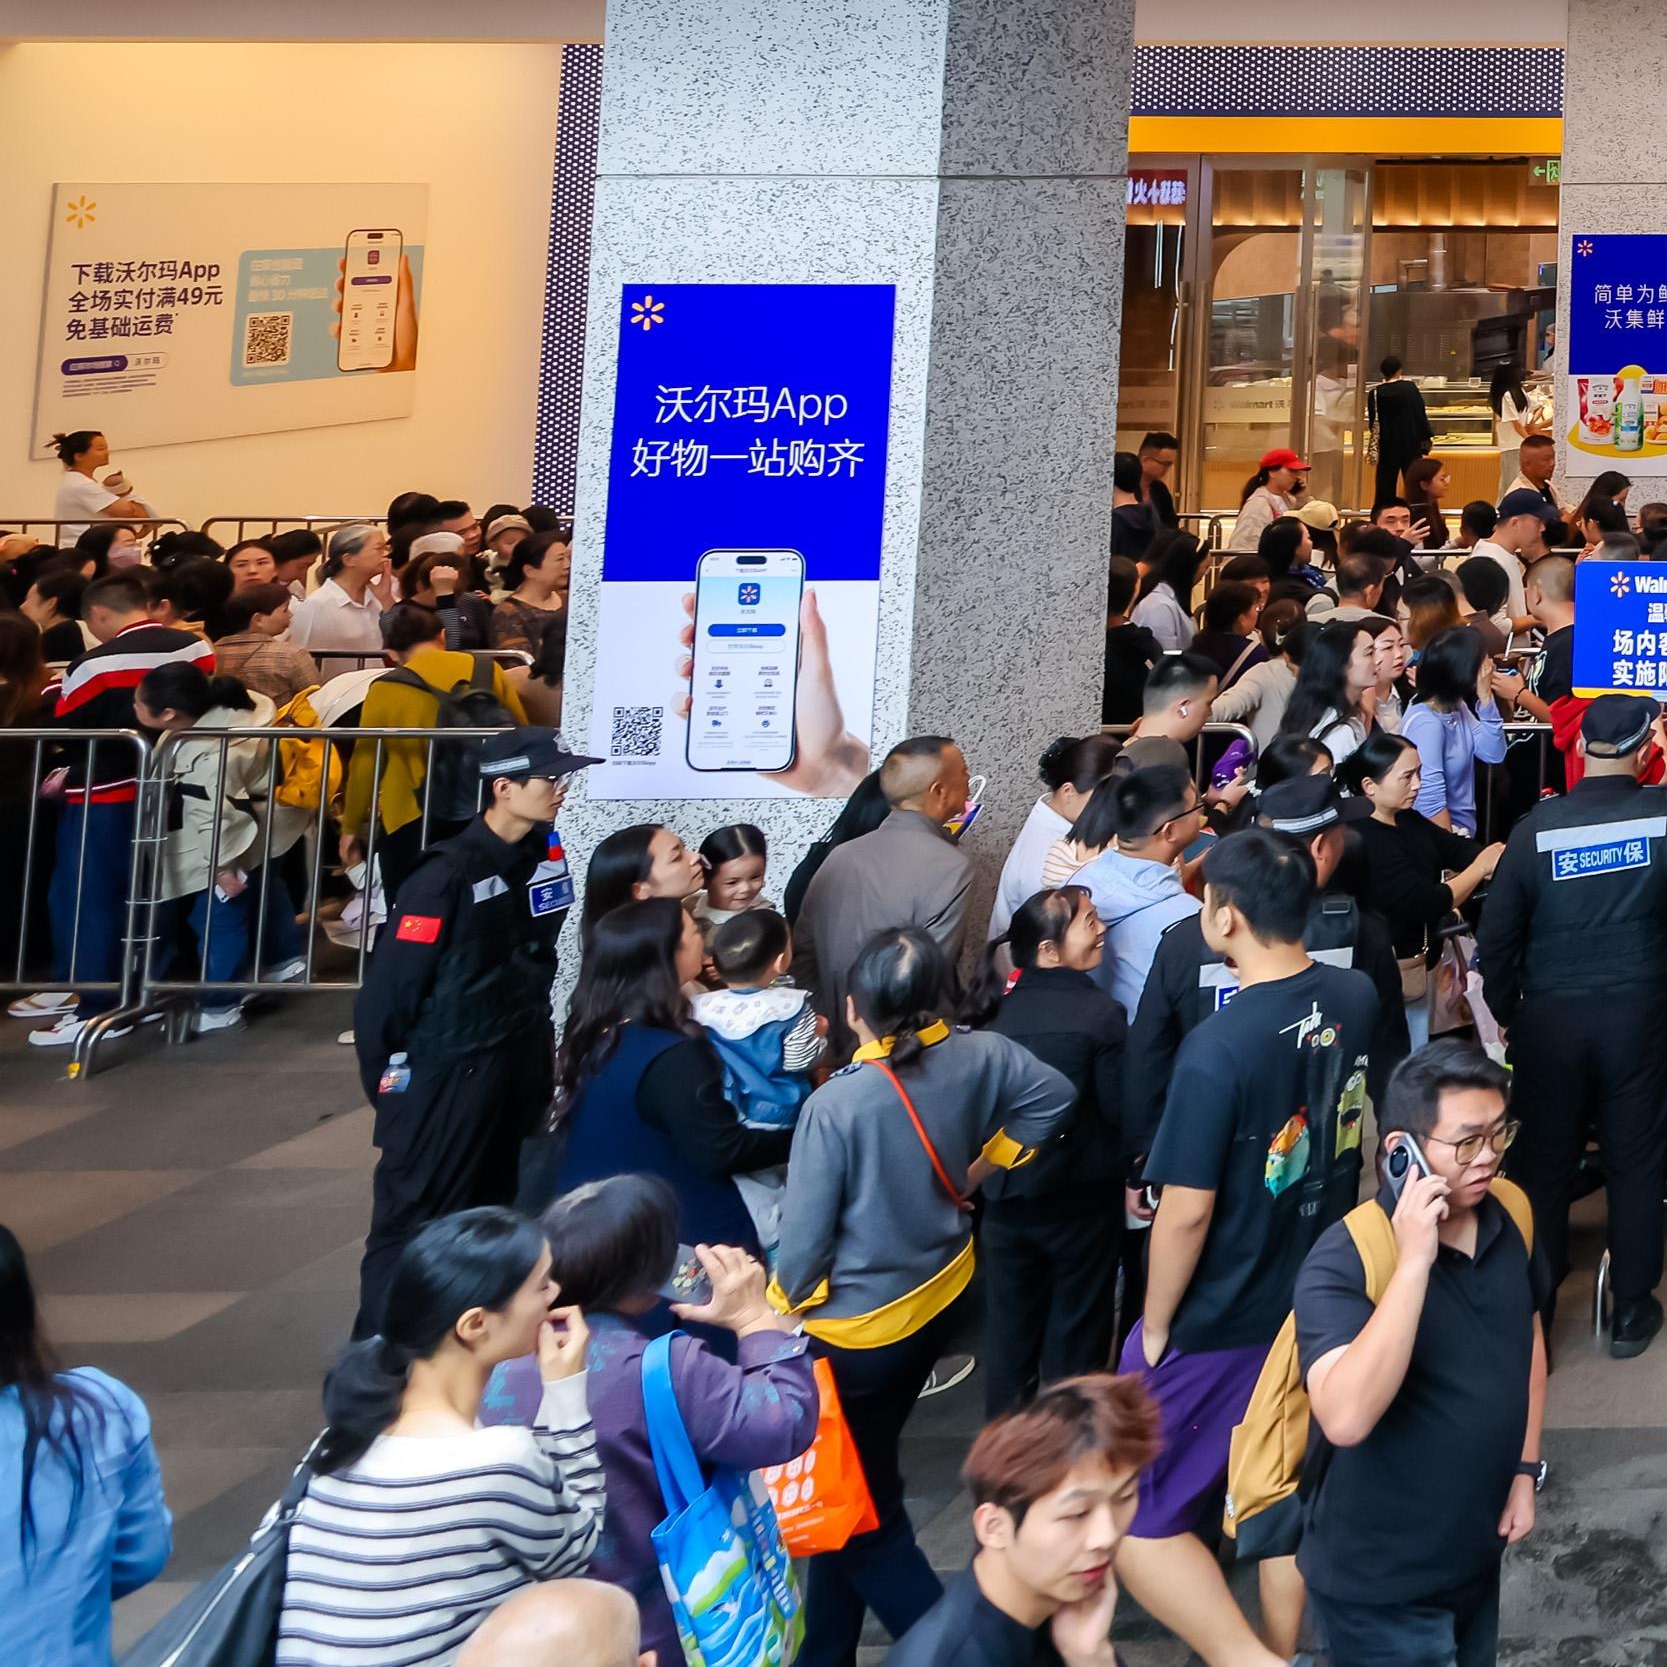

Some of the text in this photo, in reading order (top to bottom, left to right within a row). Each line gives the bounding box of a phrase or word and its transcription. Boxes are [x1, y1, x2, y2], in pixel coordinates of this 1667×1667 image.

[70, 261, 221, 284] 下载沃尔玛App
[68, 286, 224, 313] 全场实付满49元
[1604, 309, 1665, 329] 沃集鲜
[655, 385, 848, 426] 沃尔玛App
[630, 438, 865, 478] 好物一站购齐
[1557, 841, 1644, 875] 安 SECURITY 保
